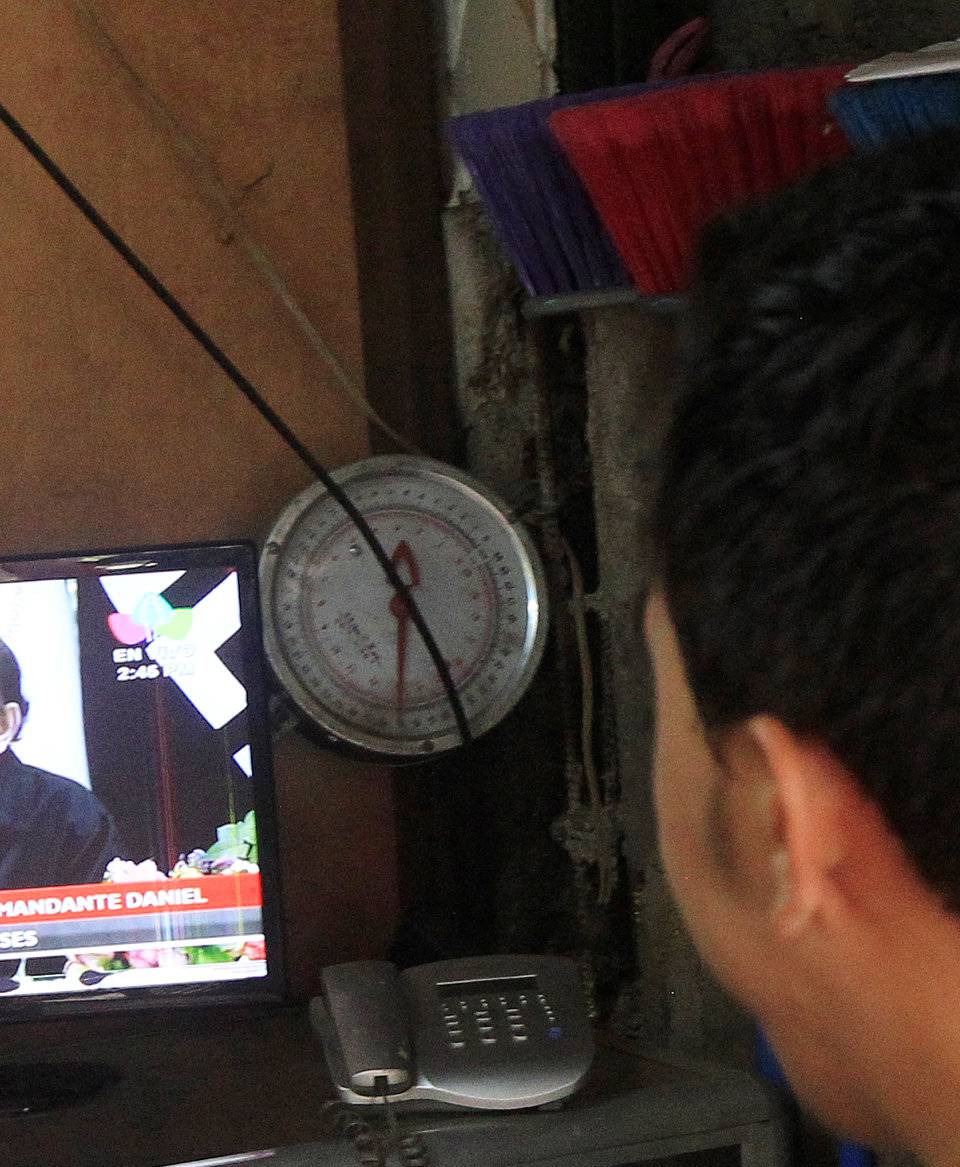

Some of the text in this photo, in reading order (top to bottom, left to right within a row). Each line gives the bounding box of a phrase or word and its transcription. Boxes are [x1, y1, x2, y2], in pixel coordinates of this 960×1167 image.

[113, 647, 143, 662] EN
[117, 664, 160, 681] 2:45
[125, 887, 208, 908] DANIEL
